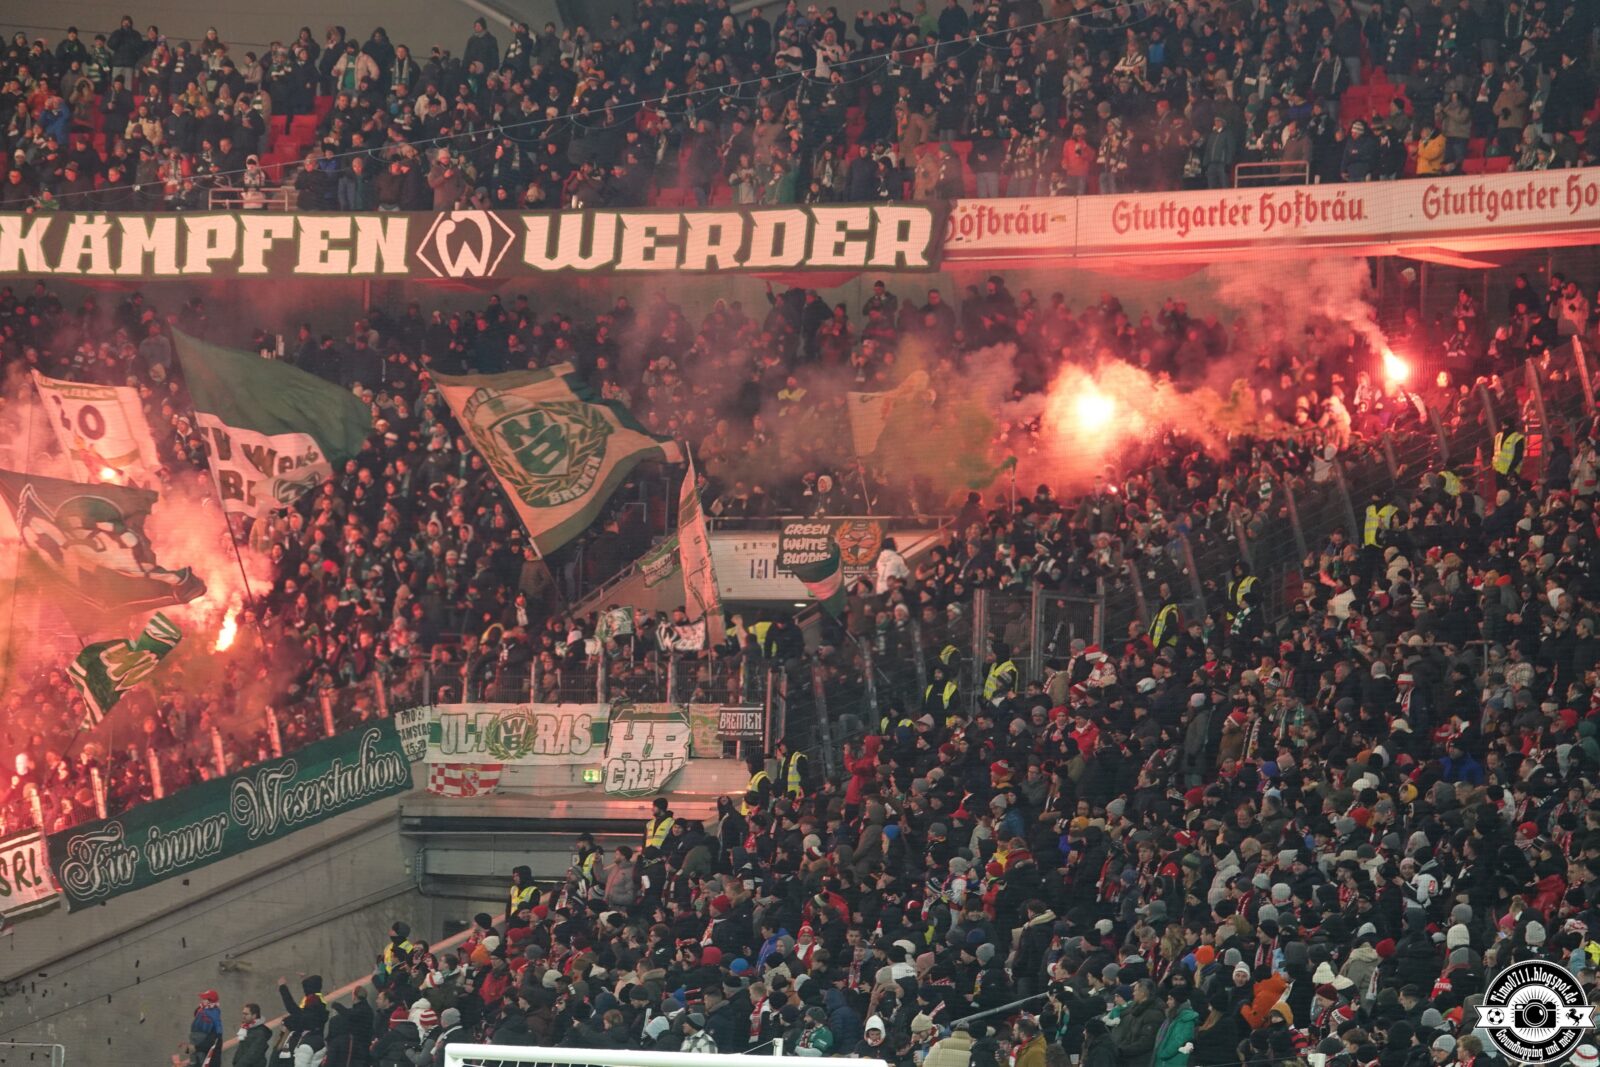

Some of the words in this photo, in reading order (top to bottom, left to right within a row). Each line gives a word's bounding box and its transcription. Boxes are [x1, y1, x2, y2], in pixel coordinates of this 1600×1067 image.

[1112, 200, 1252, 237] Stuttgarter
[1258, 190, 1364, 232] Hofbräu
[1422, 183, 1560, 222] Stuttgarter
[0, 213, 409, 275] KÄMPFEN
[521, 205, 933, 272] WERDER
[783, 538, 828, 551] WHITE
[784, 524, 832, 535] GREEN
[719, 712, 763, 731] BREMEN
[60, 821, 139, 900] Für
[145, 826, 229, 876] immer
[231, 728, 407, 840] Weserstadion
